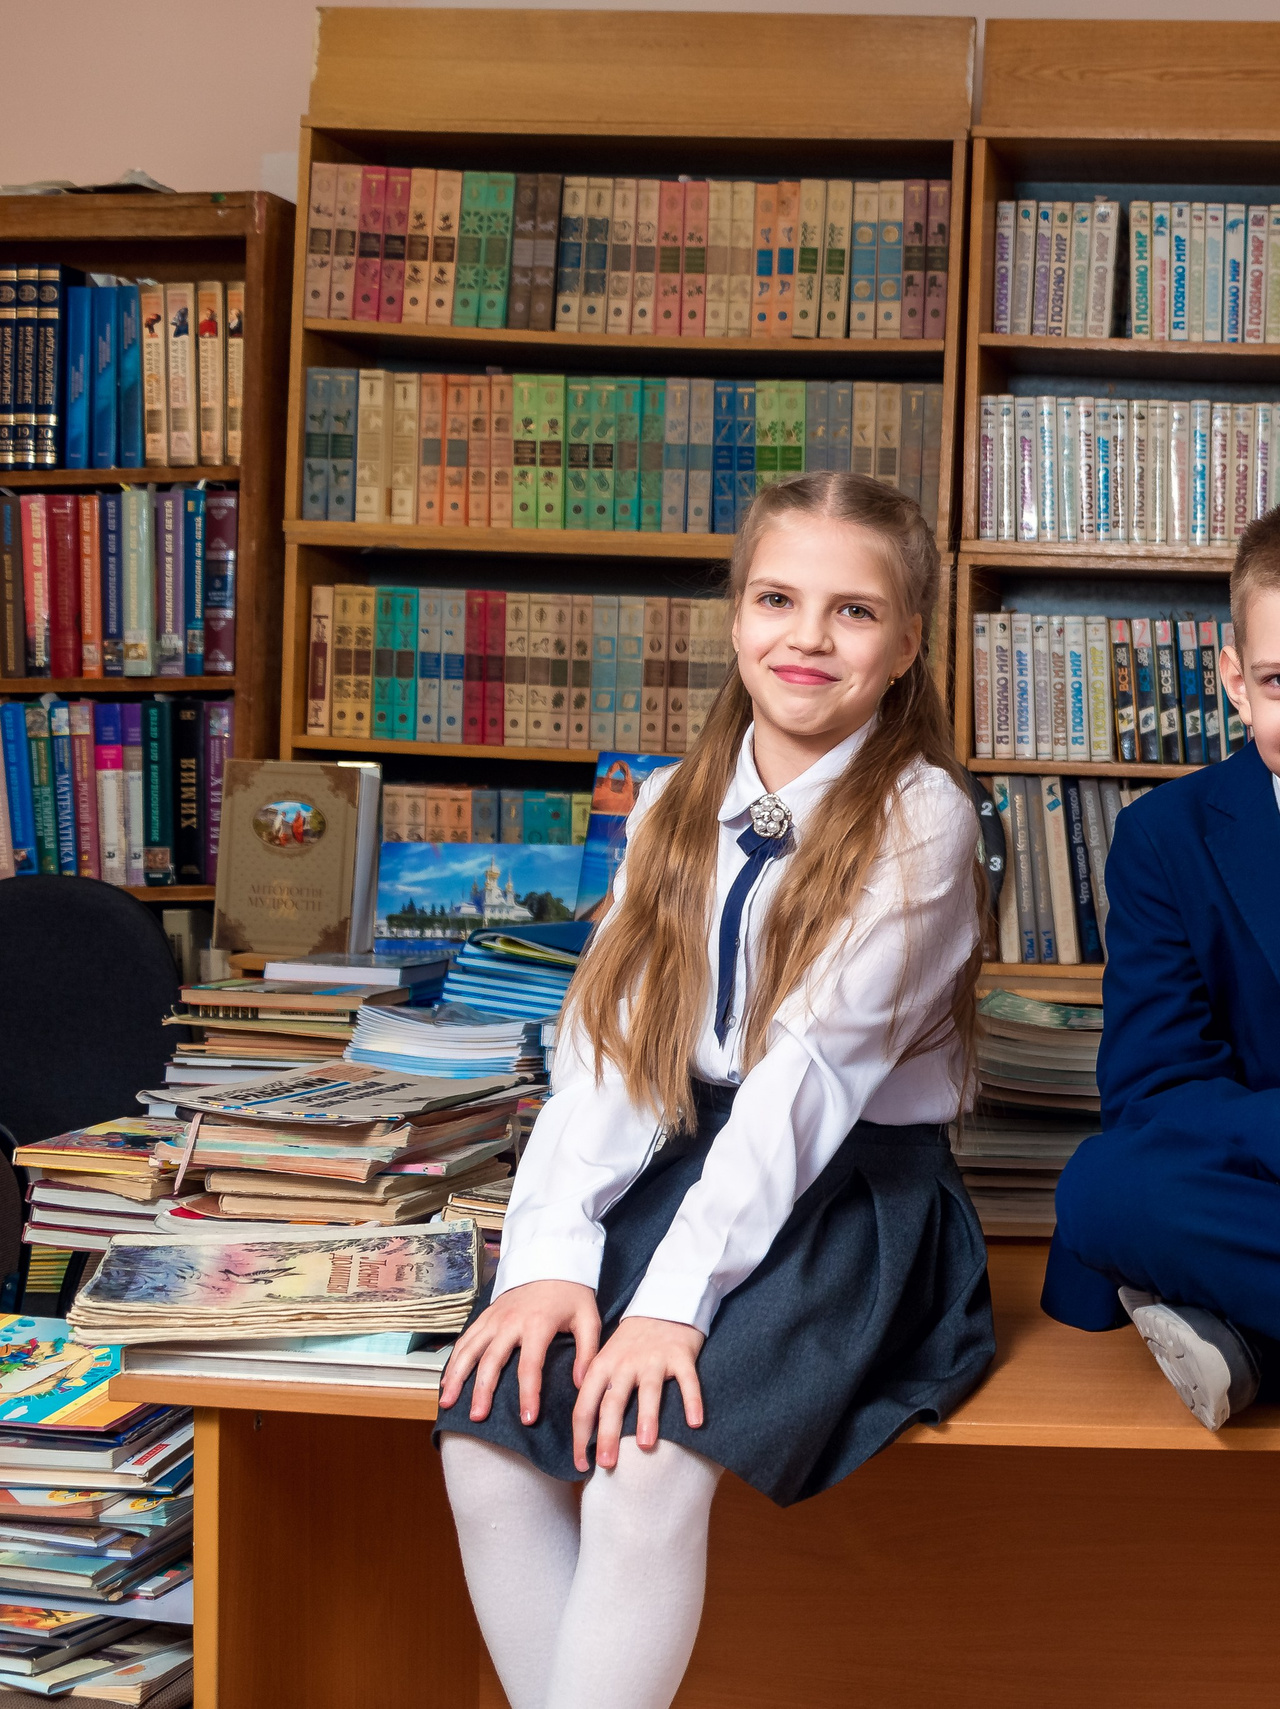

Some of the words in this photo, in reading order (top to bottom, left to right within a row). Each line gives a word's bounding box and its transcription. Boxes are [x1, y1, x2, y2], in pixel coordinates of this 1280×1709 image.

[18, 427, 29, 438] 19
[38, 427, 53, 438] 20
[1116, 620, 1126, 642] 1
[1137, 622, 1150, 647] 2
[1181, 622, 1195, 644] 4
[1201, 622, 1213, 644] 5
[995, 645, 1009, 674] МИР
[1015, 649, 1028, 677] МИР
[1052, 651, 1064, 679] МИР
[1069, 650, 1082, 678] МИР
[1090, 646, 1104, 677] МИР
[1118, 667, 1129, 692] ВСЕ
[1140, 667, 1150, 692] ВСЕ
[1161, 670, 1172, 694] ВСЕ
[1185, 671, 1196, 695] ВСЕ
[1204, 670, 1215, 695] ВСЕ
[996, 676, 1009, 732] ПОЗНАЮ
[1017, 679, 1029, 732] ПОЗНАЮ
[1052, 681, 1066, 734] ПОЗНАЮ
[1071, 680, 1084, 733] ПОЗНАЮ
[1091, 680, 1107, 737] ПОЗНАЮ
[995, 735, 1010, 746] Я
[1016, 735, 1029, 745] Я
[1053, 736, 1066, 747] Я
[1071, 735, 1084, 746] Я
[1093, 739, 1107, 751] Я
[180, 758, 197, 829] ХИМИЯ
[1068, 787, 1081, 823] такой
[56, 773, 74, 864] МАТЕМАТИКА
[981, 802, 993, 816] 2
[1072, 824, 1083, 845] Кто
[989, 856, 1002, 872] 3
[1075, 846, 1088, 879] такое
[250, 884, 322, 898] АНТОЛОГИЯ
[1080, 880, 1091, 905] Что
[248, 896, 321, 911] МУДРОСТИ
[1025, 938, 1034, 961] Том
[1043, 938, 1053, 961] Том
